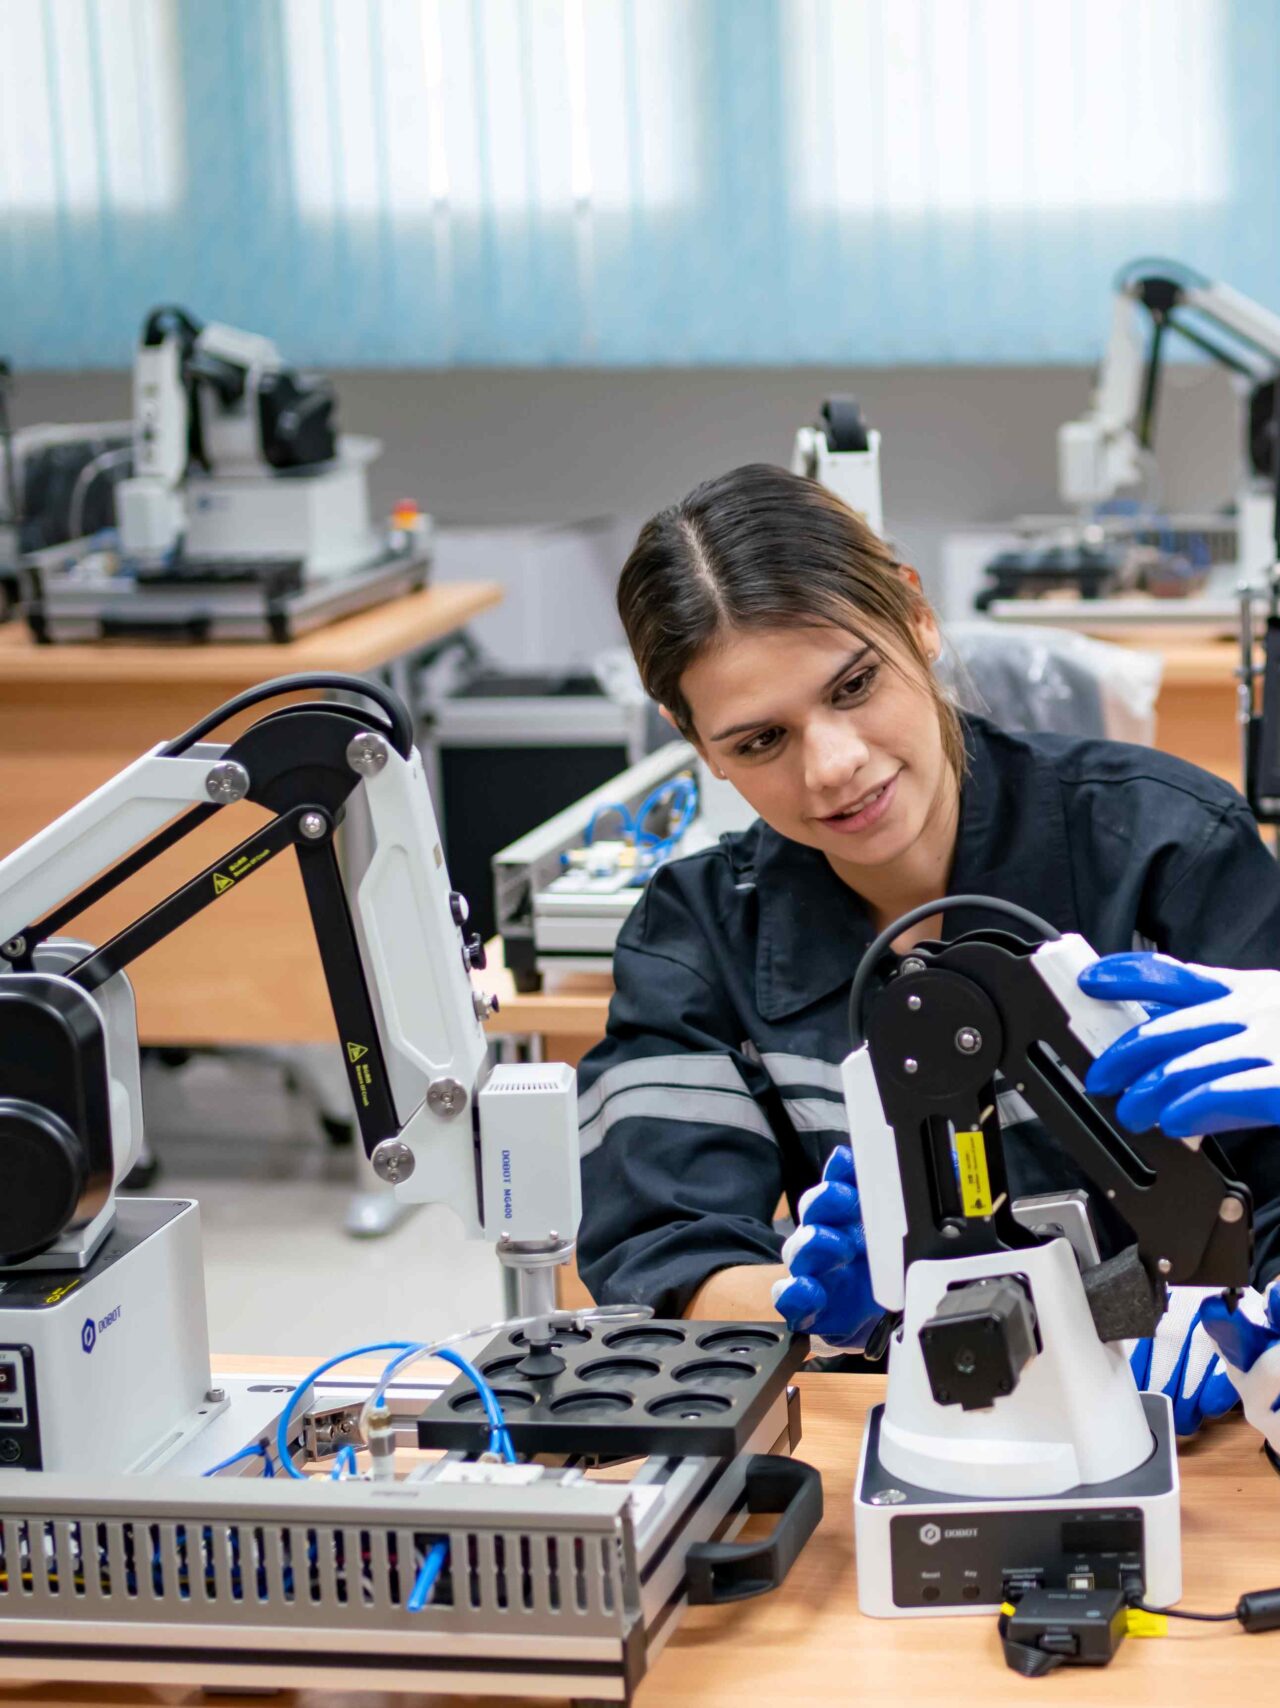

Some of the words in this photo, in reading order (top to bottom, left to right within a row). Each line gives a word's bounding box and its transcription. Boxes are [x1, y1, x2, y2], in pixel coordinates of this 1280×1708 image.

[501, 1149, 511, 1183] DOBOT
[503, 1188, 513, 1220] MG400
[97, 1304, 122, 1334] DOBOT
[943, 1527, 979, 1539] DOBOT
[1074, 1563, 1090, 1573] USB
